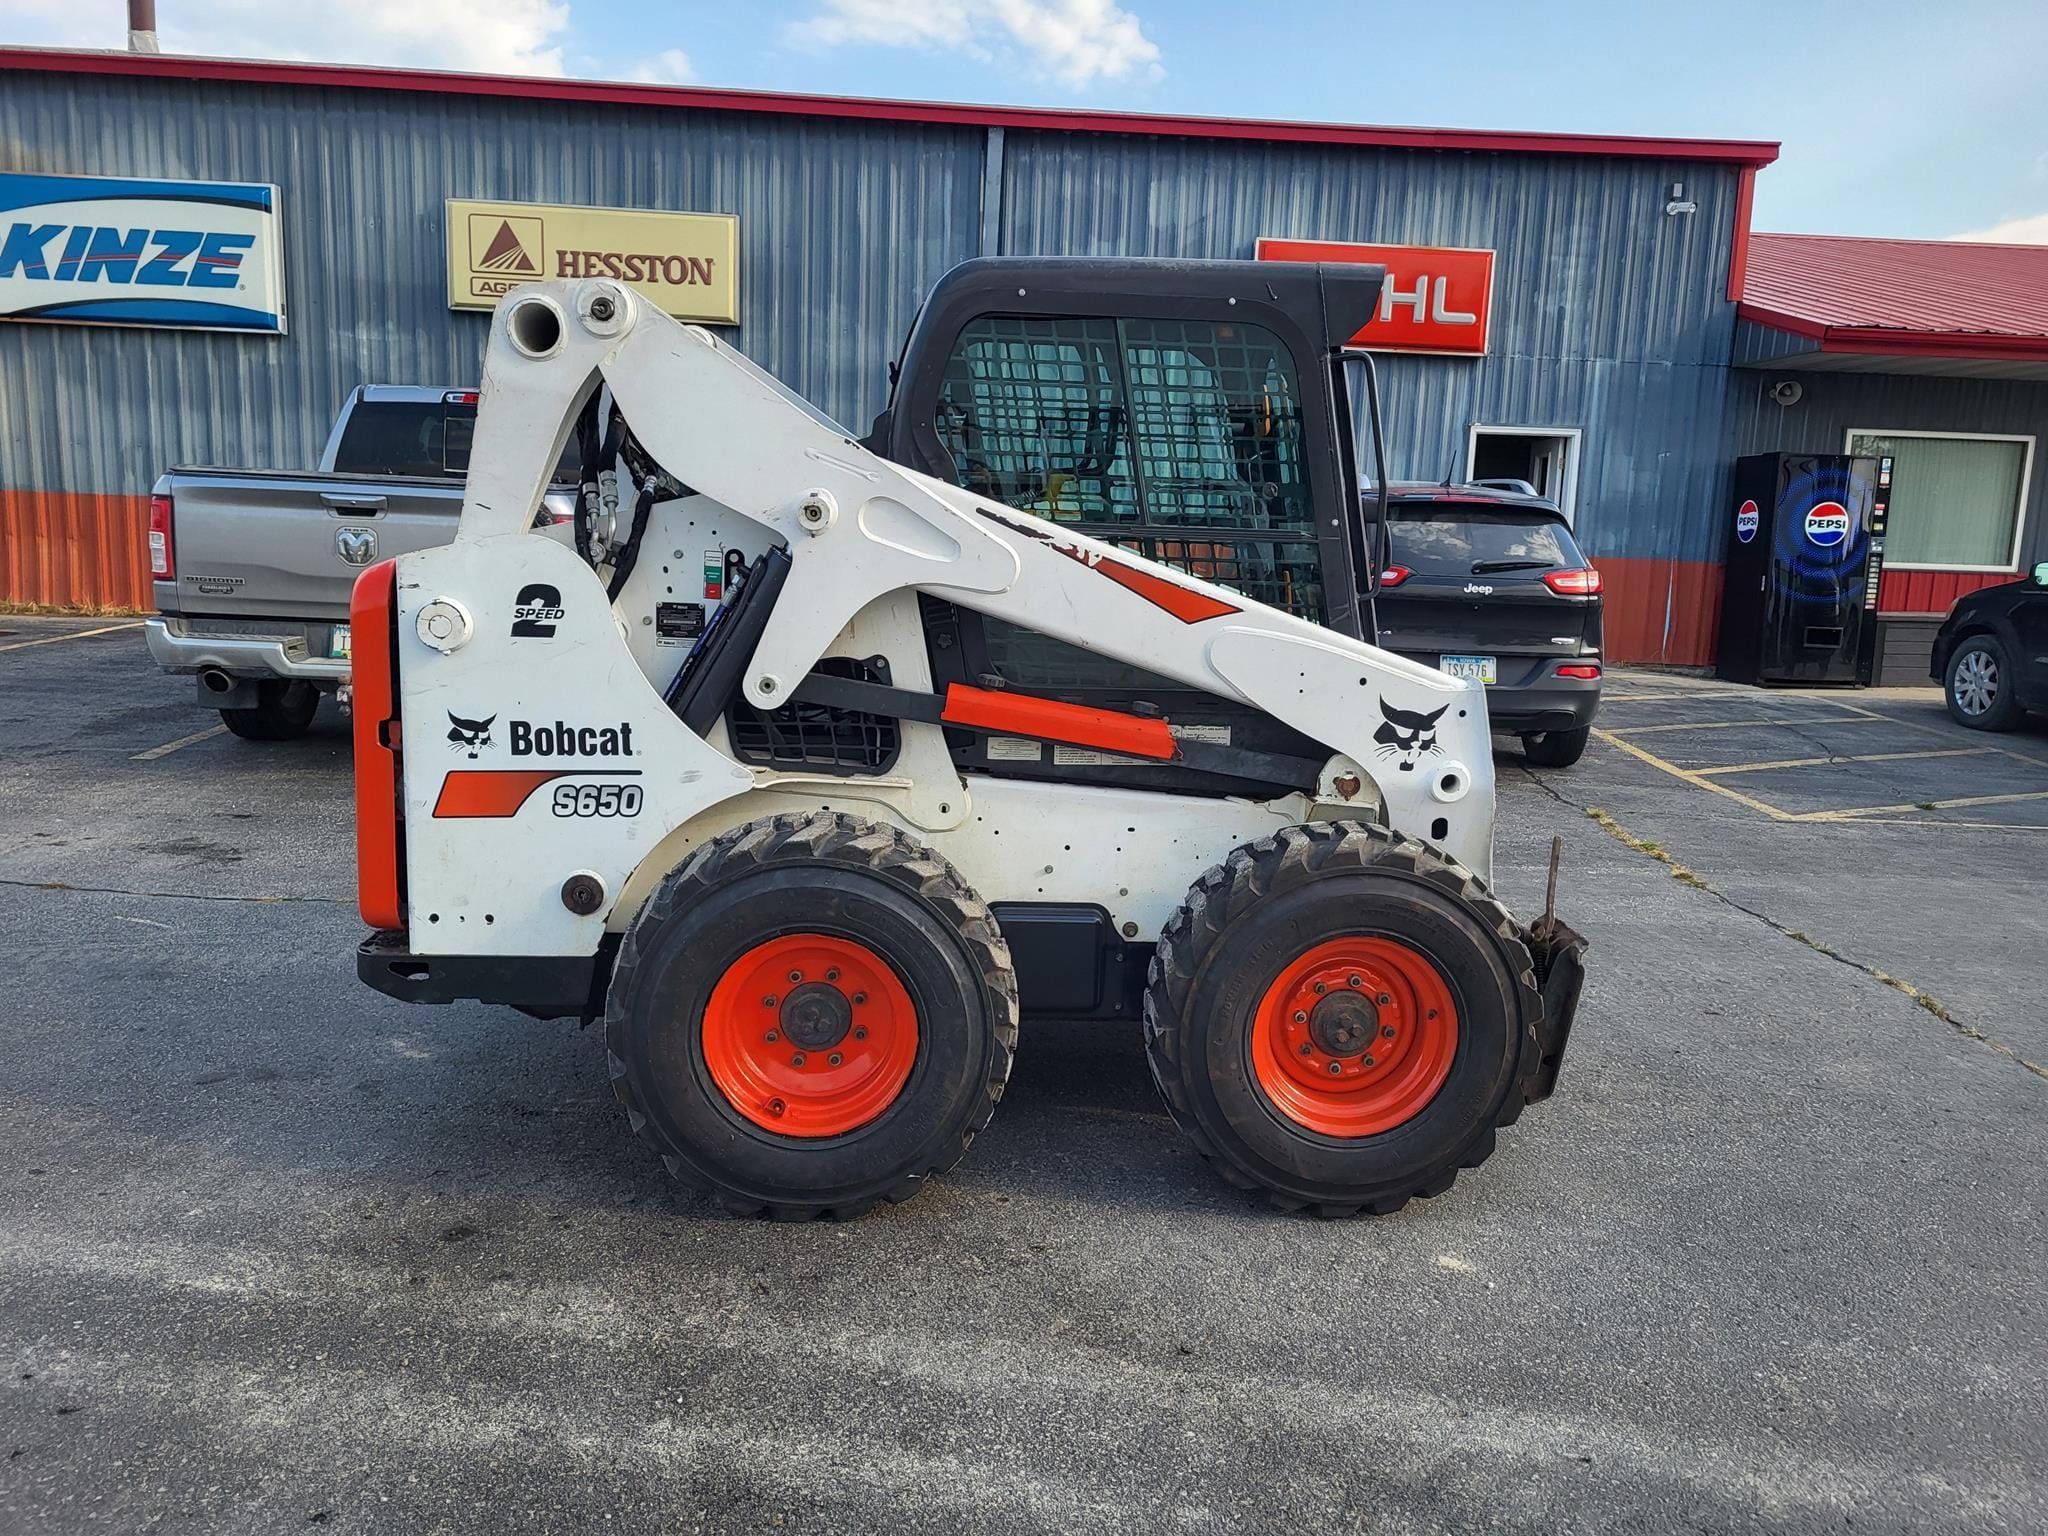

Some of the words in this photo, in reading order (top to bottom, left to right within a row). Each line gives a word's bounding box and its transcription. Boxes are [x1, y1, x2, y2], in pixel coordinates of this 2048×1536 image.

[0, 223, 256, 288] KINZE
[556, 250, 714, 285] HESSTON
[1380, 273, 1477, 325] HL
[1738, 516, 1757, 527] PEPSI
[1808, 519, 1846, 529] PEPSI
[1463, 583, 1493, 595] Jeep
[510, 583, 562, 638] 2
[513, 607, 565, 619] SPEED
[1468, 663, 1487, 677] 576
[509, 720, 633, 757] Bobcat
[552, 784, 643, 818] S650
